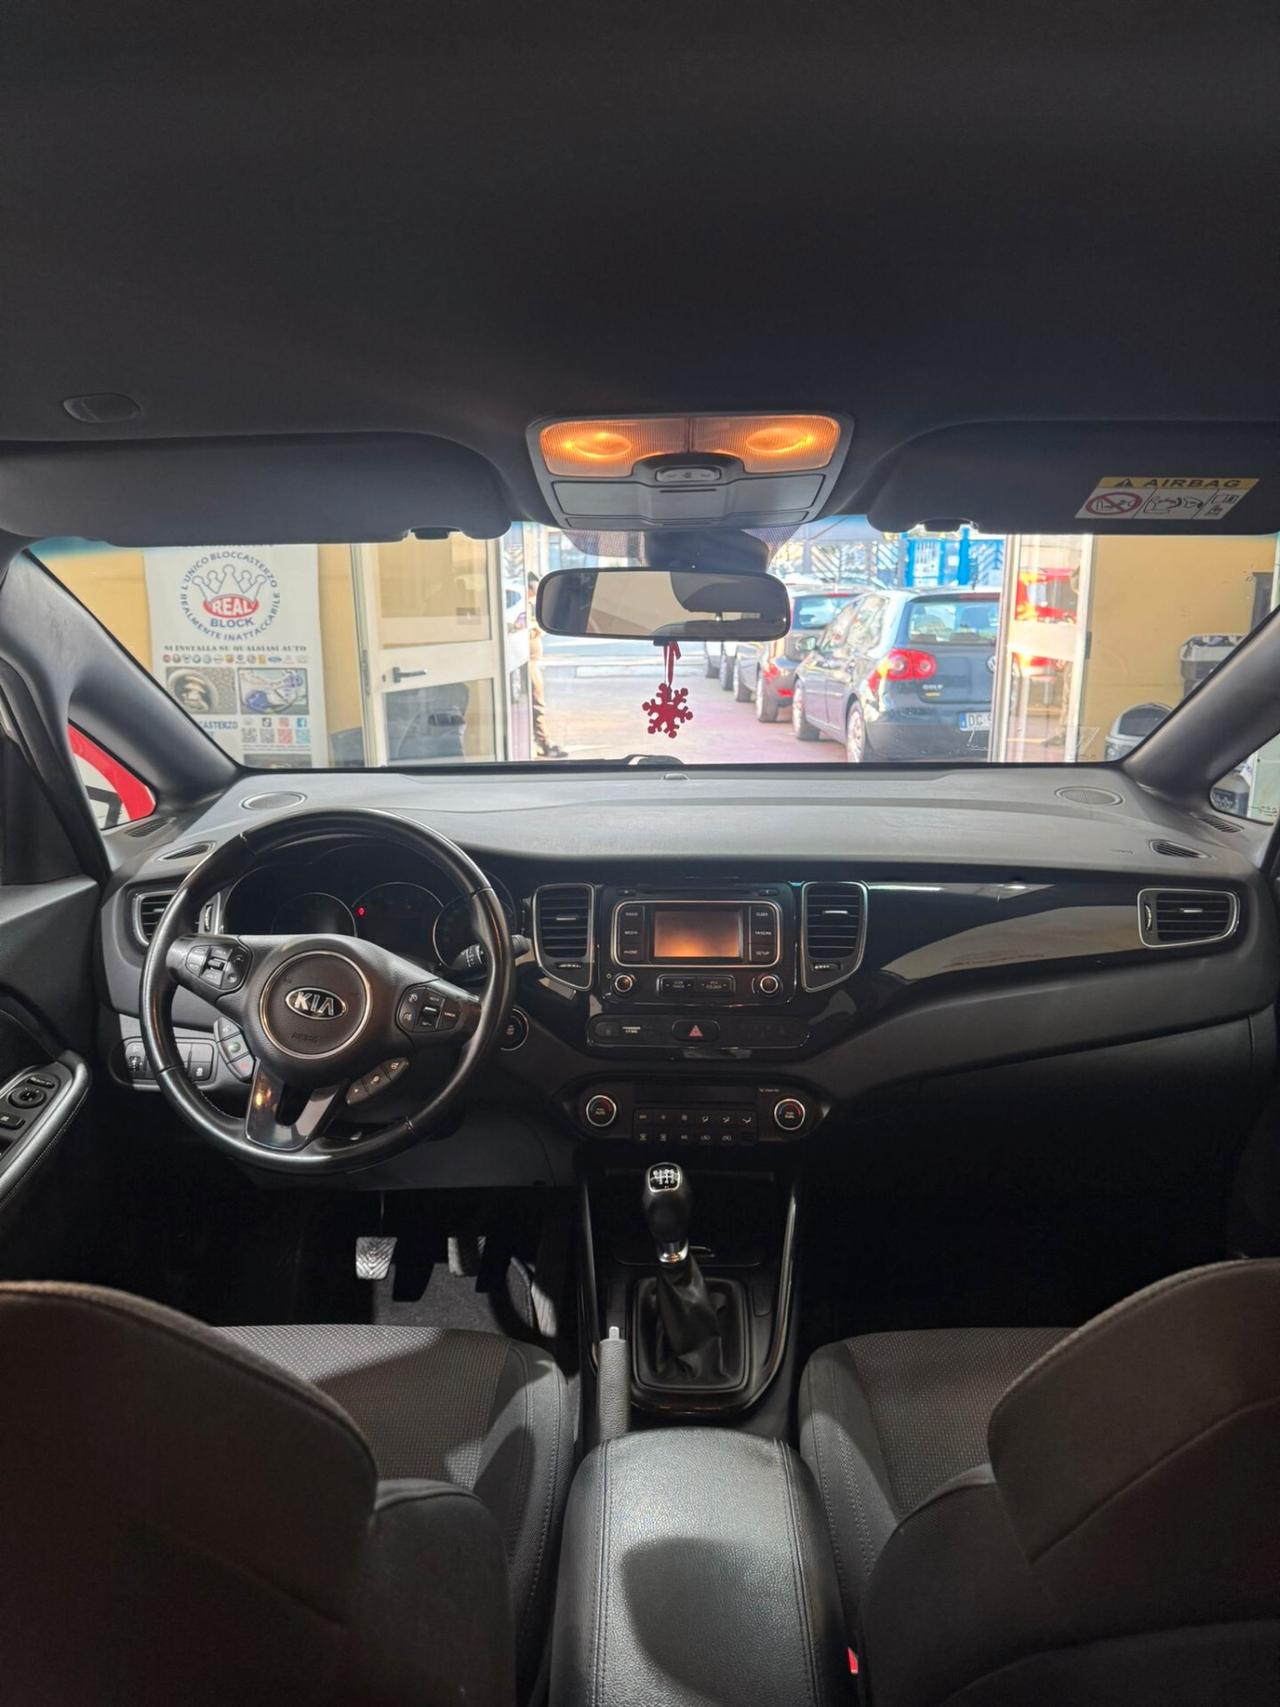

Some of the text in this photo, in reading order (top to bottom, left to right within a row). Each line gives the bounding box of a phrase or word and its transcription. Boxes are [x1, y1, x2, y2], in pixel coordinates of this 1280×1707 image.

[1144, 479, 1241, 488] AIRBAG
[211, 597, 252, 615] REAL
[210, 618, 254, 628] BLOCK
[294, 991, 335, 1016] KIA
